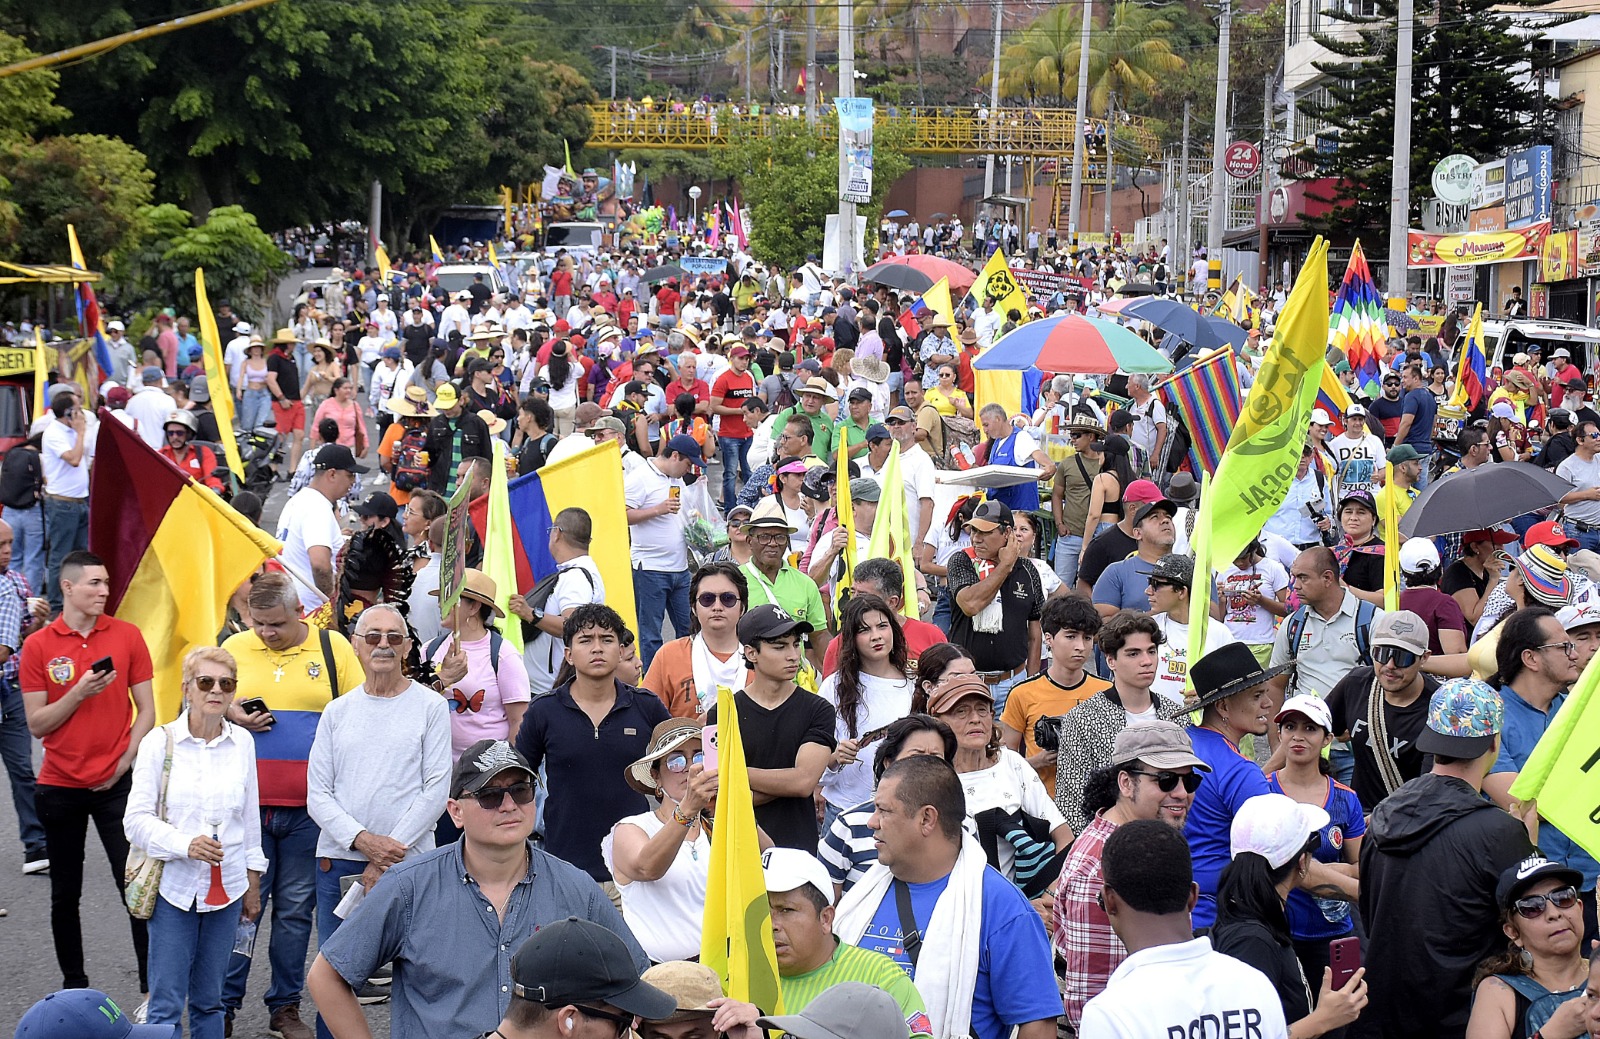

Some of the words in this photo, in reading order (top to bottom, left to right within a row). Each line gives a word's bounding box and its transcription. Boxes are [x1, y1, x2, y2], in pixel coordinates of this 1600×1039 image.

[1232, 147, 1252, 160] 24
[1229, 160, 1253, 168] Horas
[1435, 202, 1469, 227] BISTRO
[1339, 446, 1374, 461] DSL
[1350, 718, 1409, 759] FX
[1520, 857, 1548, 872] NIKE
